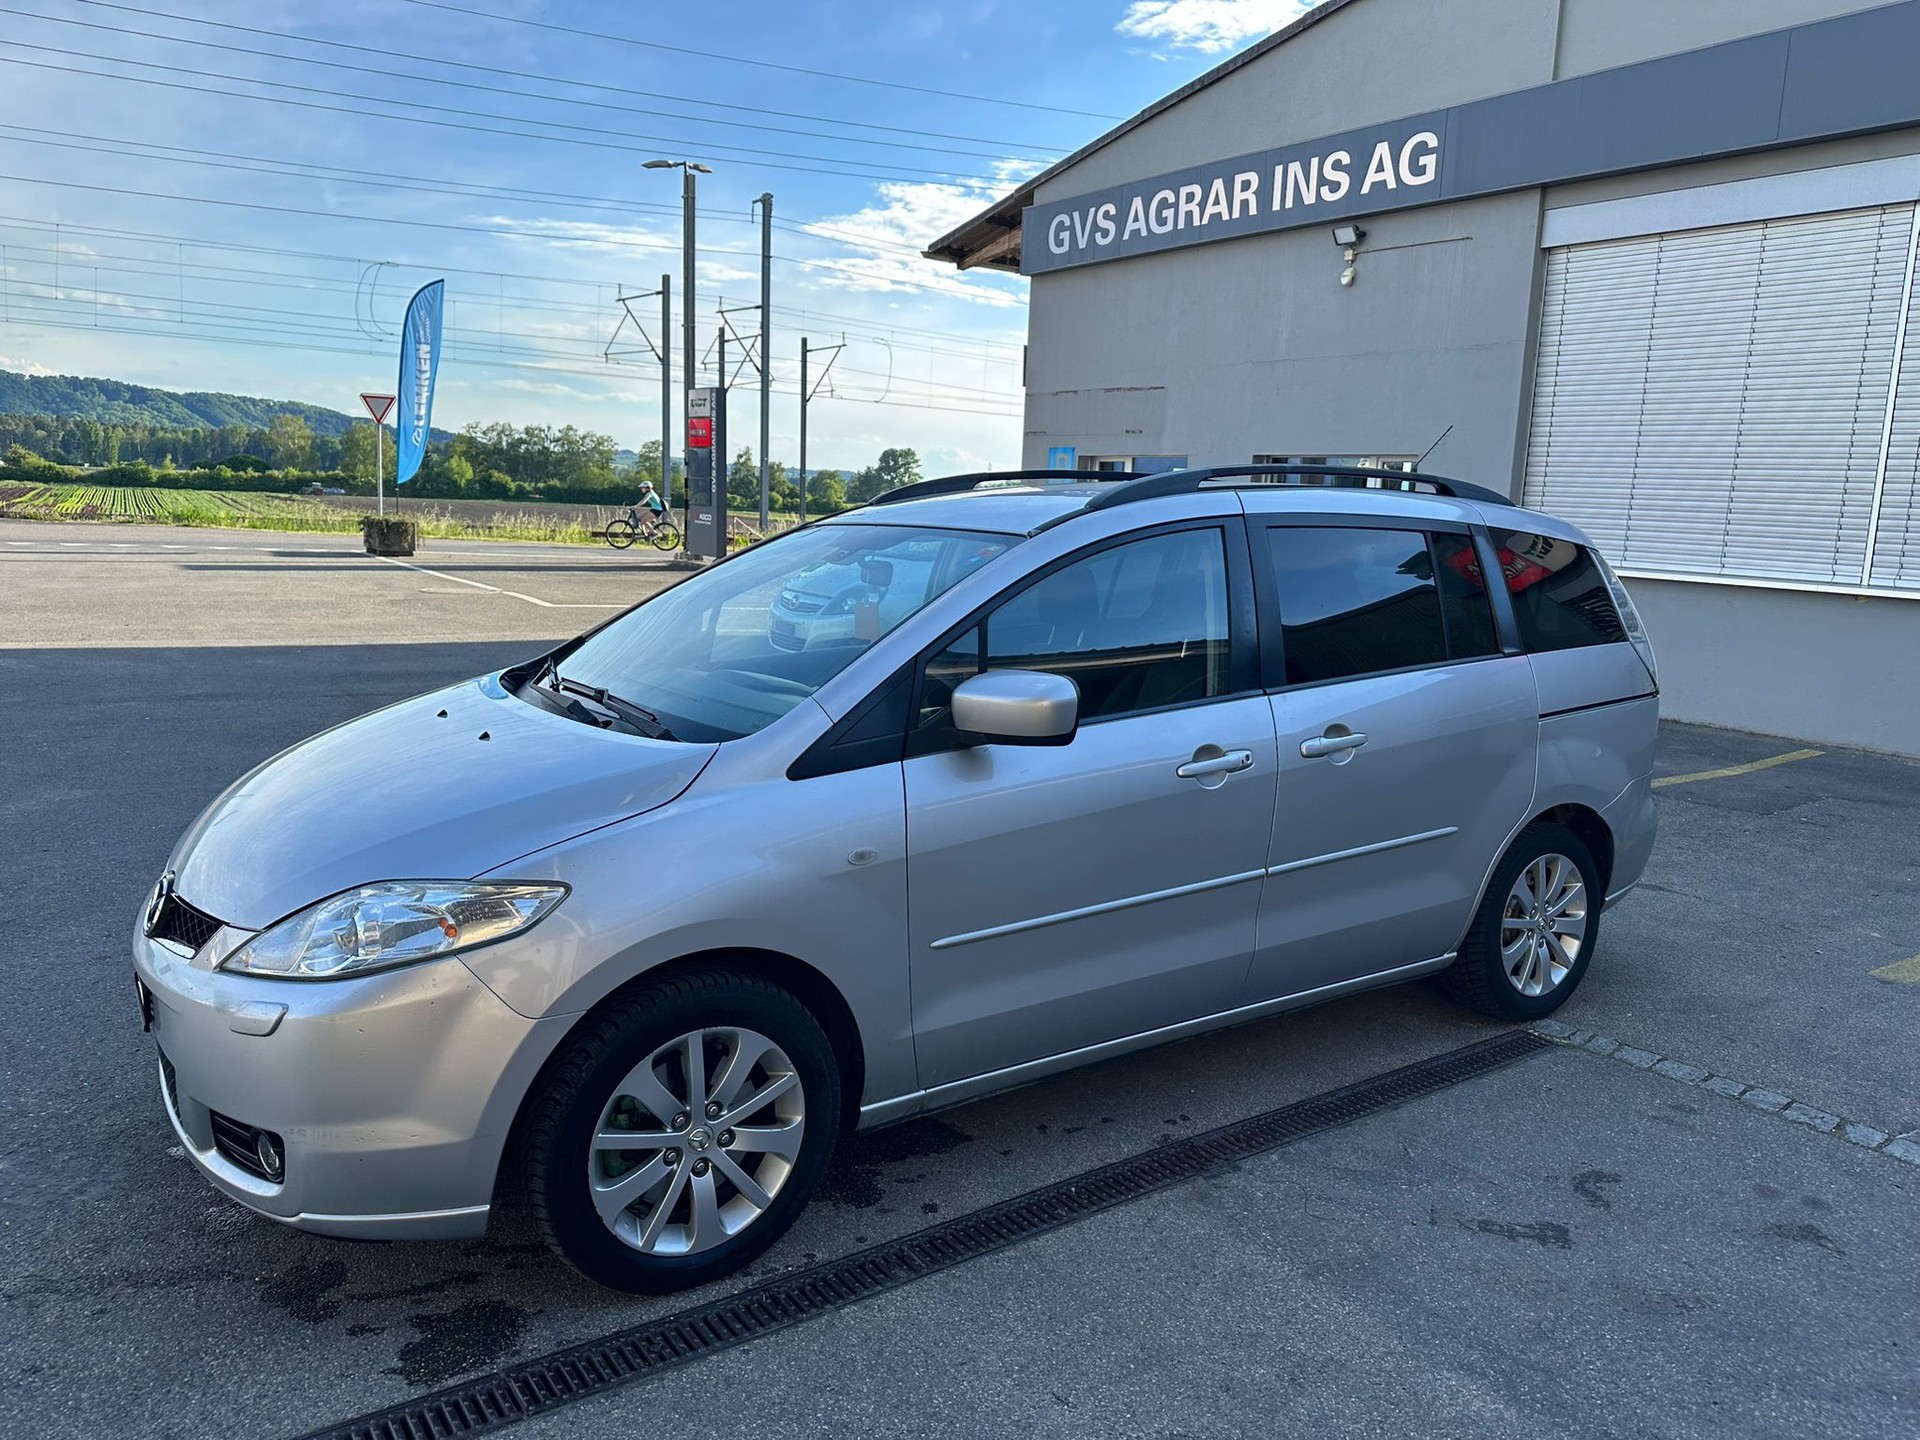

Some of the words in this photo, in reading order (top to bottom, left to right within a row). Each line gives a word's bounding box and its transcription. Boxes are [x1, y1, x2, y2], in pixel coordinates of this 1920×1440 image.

[1048, 202, 1116, 255] GVS
[1122, 171, 1260, 241] AGRAR
[1272, 150, 1351, 212] INS
[1360, 131, 1439, 195] AG
